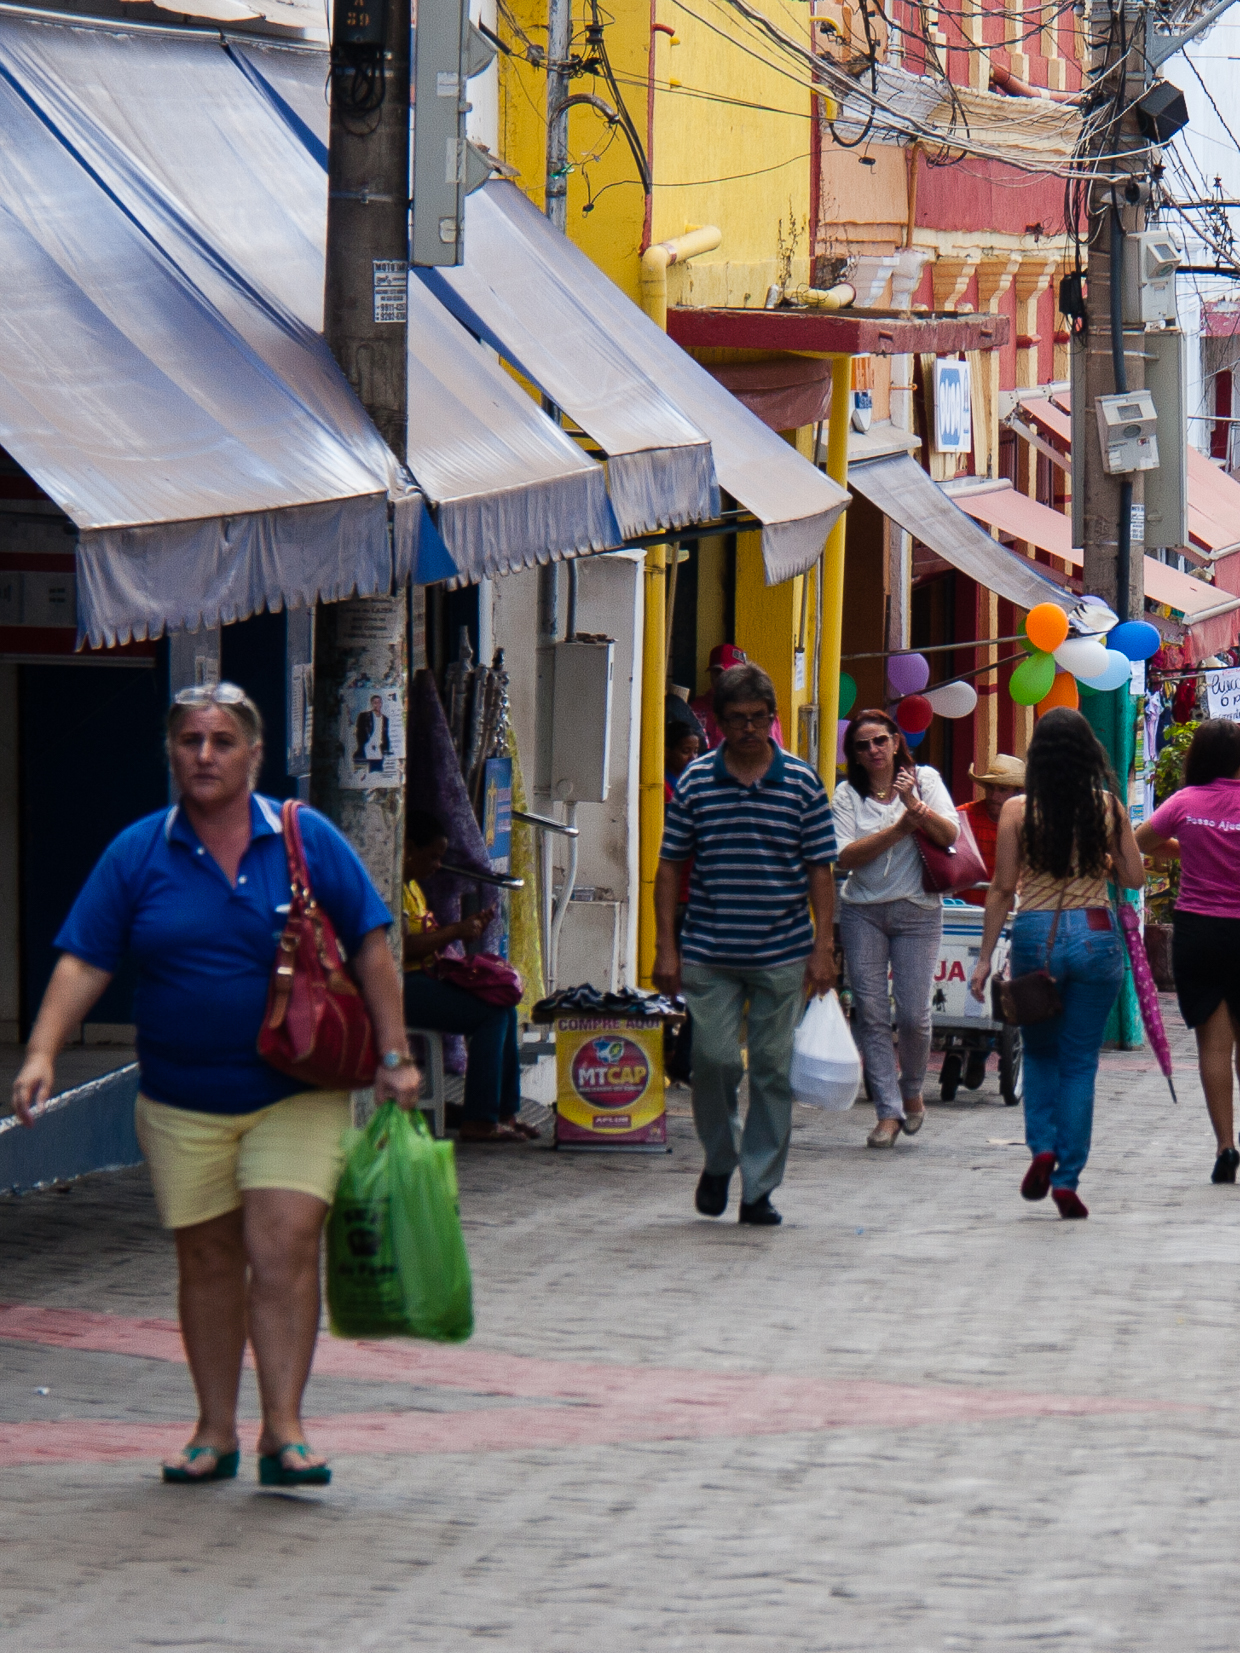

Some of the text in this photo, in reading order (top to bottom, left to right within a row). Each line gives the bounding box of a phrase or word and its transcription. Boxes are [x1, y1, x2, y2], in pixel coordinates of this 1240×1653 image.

[1185, 816, 1216, 827] Posso
[557, 1018, 621, 1032] COMPRE
[578, 1065, 647, 1087] MTCAP
